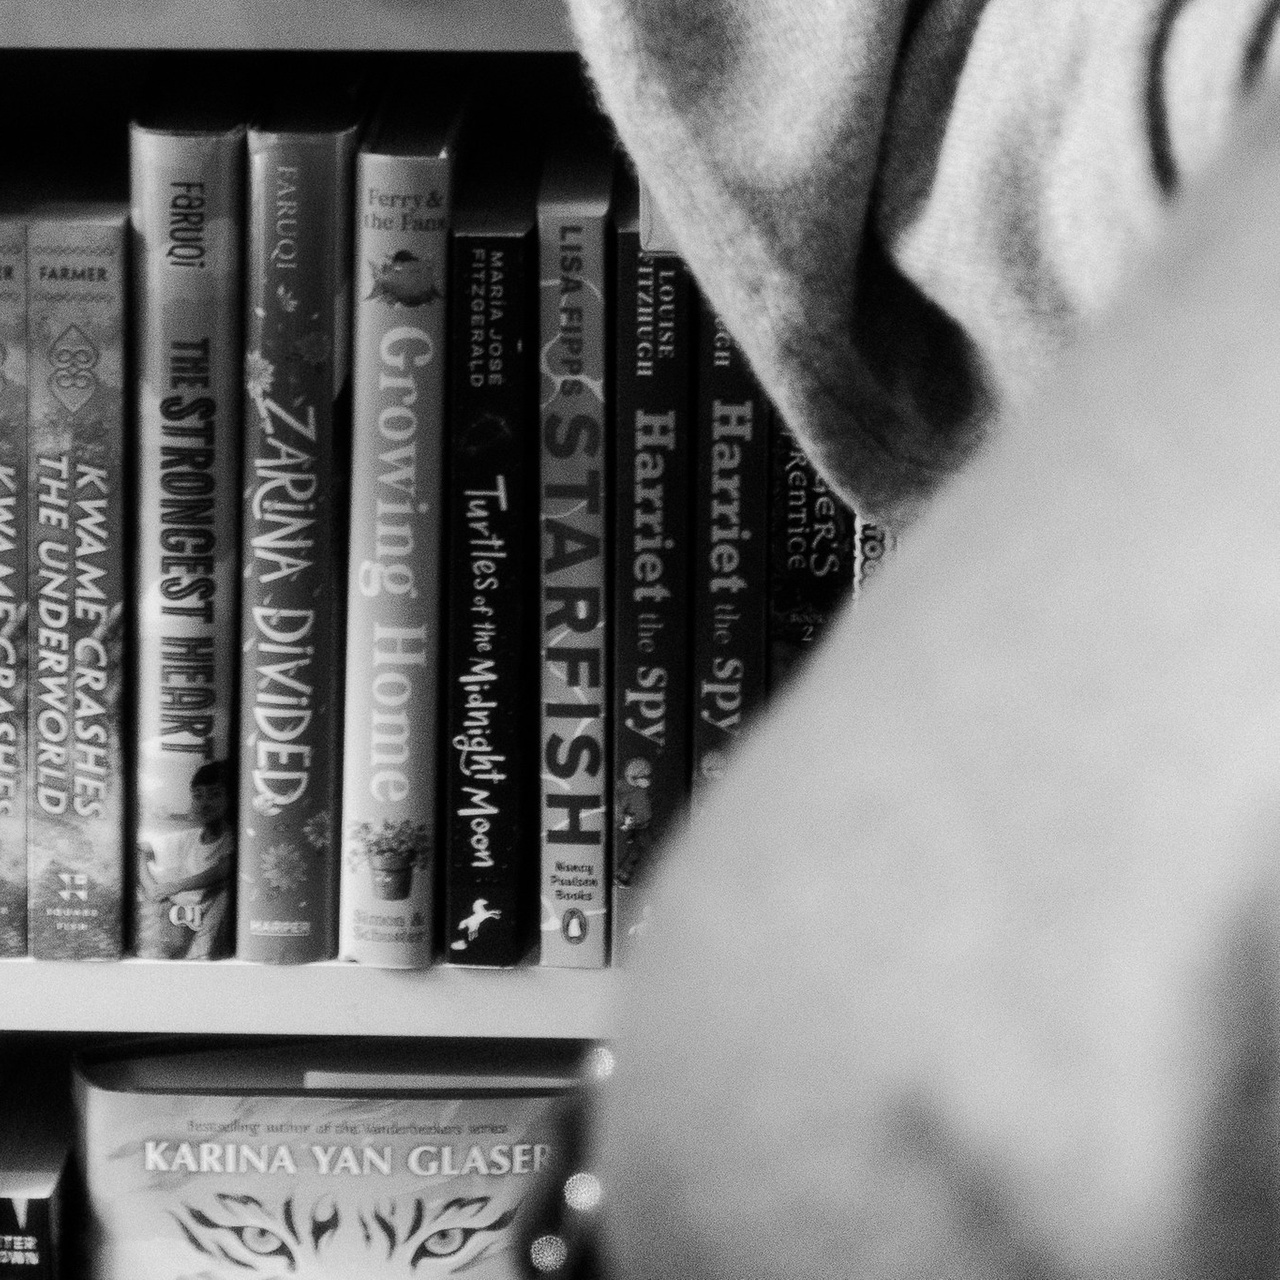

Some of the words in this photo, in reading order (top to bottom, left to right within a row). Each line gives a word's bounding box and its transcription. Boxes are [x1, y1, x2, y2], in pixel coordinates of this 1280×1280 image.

[38, 266, 108, 282] FARMER
[270, 166, 299, 269] FARUQI
[559, 226, 582, 296] LISA
[170, 338, 210, 389] THE
[470, 248, 486, 388] FITZGERALD
[658, 270, 676, 359] LOUISE
[38, 456, 69, 530] THE
[160, 396, 217, 624] STRONGEST
[358, 326, 433, 599] Growing
[632, 410, 676, 603] Harriet
[710, 399, 754, 594] Harriet
[75, 464, 109, 621] KWAME
[465, 475, 508, 591] Turtles
[470, 623, 497, 652] the
[471, 595, 493, 621] of
[544, 414, 603, 845] STARFISH
[638, 613, 665, 653] the
[37, 540, 69, 816] UNDERWORLD
[74, 638, 109, 817] CRASHES
[161, 636, 217, 760] HEART
[370, 624, 427, 802] Home
[452, 659, 506, 784] Midnight
[625, 665, 667, 747] spy
[458, 788, 500, 868] Moon
[144, 1142, 297, 1174] KARINA
[313, 1145, 392, 1175] YAN
[407, 1143, 551, 1177] GLASER
